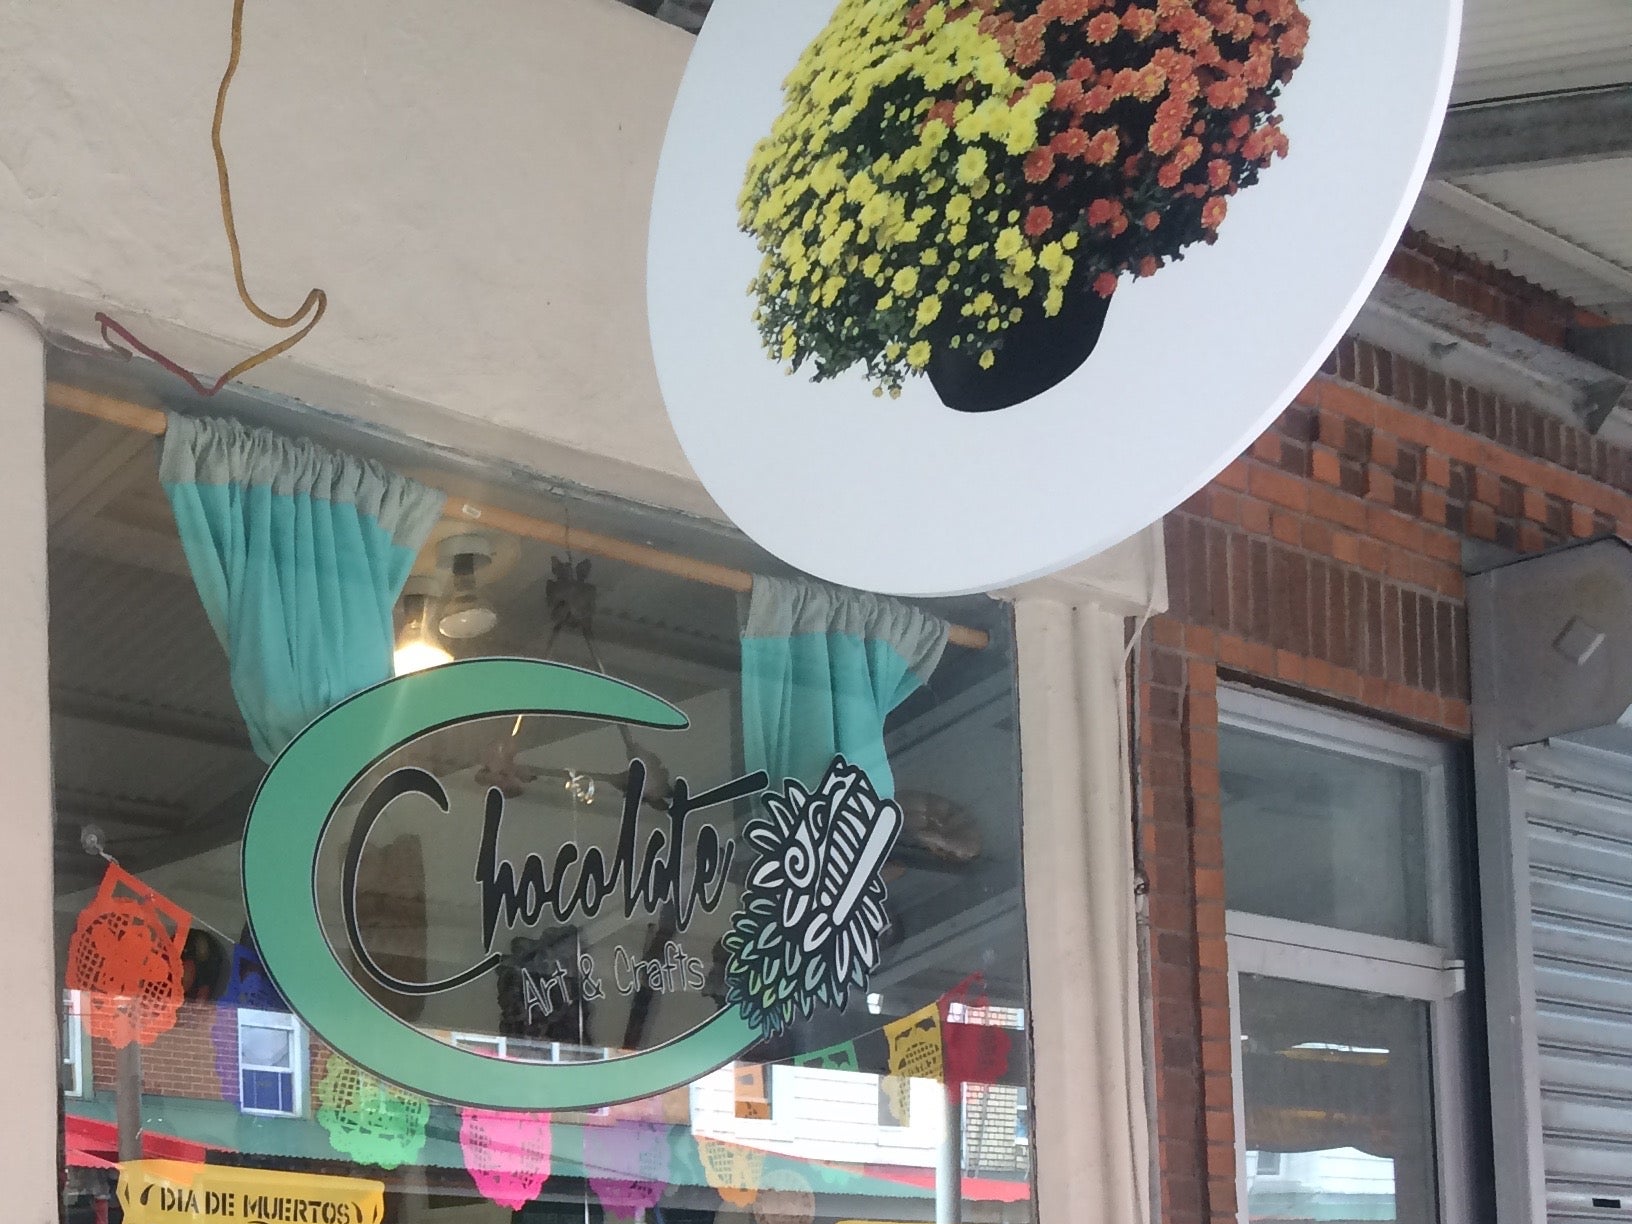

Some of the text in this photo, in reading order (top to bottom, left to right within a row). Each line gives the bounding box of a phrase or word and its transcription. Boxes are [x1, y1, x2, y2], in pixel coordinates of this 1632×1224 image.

[343, 757, 769, 996] Chocolate
[521, 940, 706, 1025] Art & Crafts
[160, 1186, 200, 1214] DIA
[205, 1190, 235, 1217] DE
